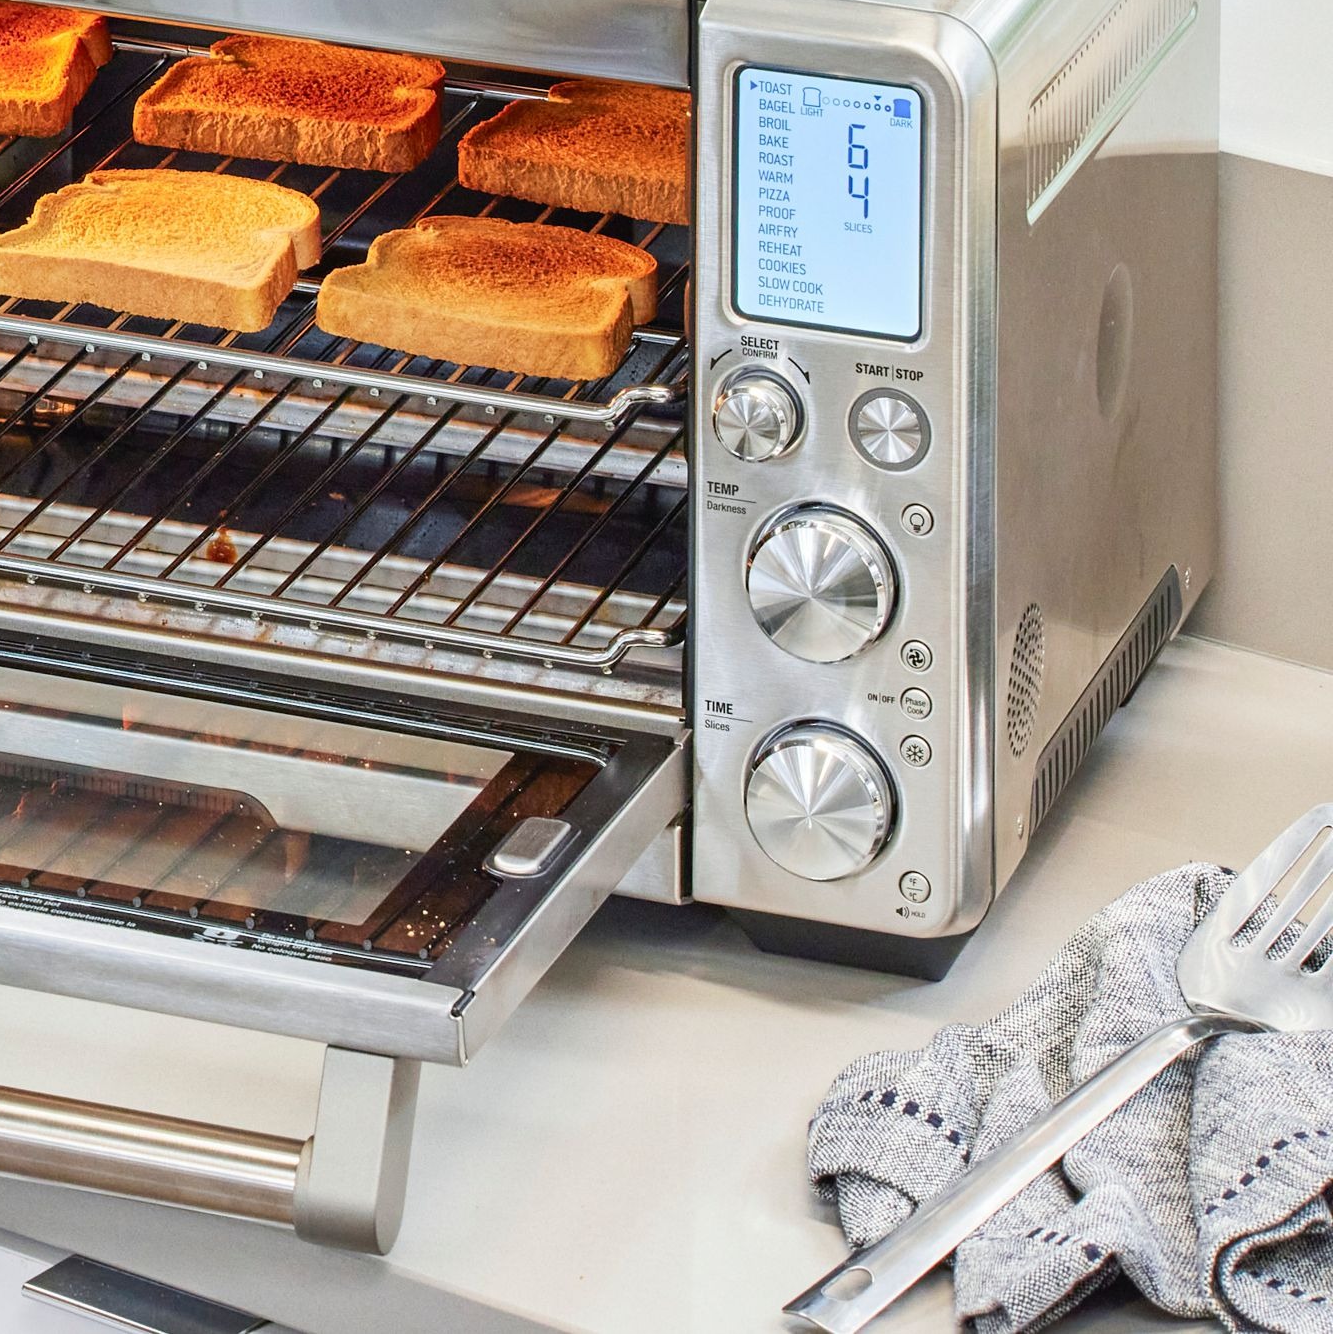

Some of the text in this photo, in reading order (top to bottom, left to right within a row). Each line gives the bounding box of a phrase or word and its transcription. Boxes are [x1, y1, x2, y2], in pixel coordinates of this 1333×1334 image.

[758, 80, 792, 95] TOAST
[759, 99, 795, 115] BAGEL
[801, 107, 824, 117] LIGHT
[759, 116, 792, 132] BROIL
[889, 118, 913, 129] DARK
[759, 134, 789, 149] BAKE
[848, 123, 869, 170] 6
[759, 152, 794, 167] ROAST
[758, 170, 793, 185] WARM
[759, 187, 790, 202] PIZZA
[848, 175, 869, 220] 4
[759, 205, 796, 221] PROOF
[758, 223, 798, 239] AIRFRY
[844, 222, 873, 234] SLICES
[759, 241, 802, 257] REHEAT
[758, 258, 806, 275] COOKIES
[758, 276, 823, 296] SLOW COOK
[758, 293, 824, 313] DEHYDRATE
[740, 335, 779, 351] SELECT
[742, 347, 778, 360] CONFIRM
[855, 362, 924, 382] START STOP
[707, 481, 739, 497] TEMP
[706, 500, 747, 515] Darkness
[867, 693, 895, 704] ON OFF
[905, 697, 926, 707] Phase
[705, 699, 733, 716] TIME
[907, 706, 924, 715] Cook
[704, 719, 730, 732] Slices
[911, 910, 926, 918] HOLD
